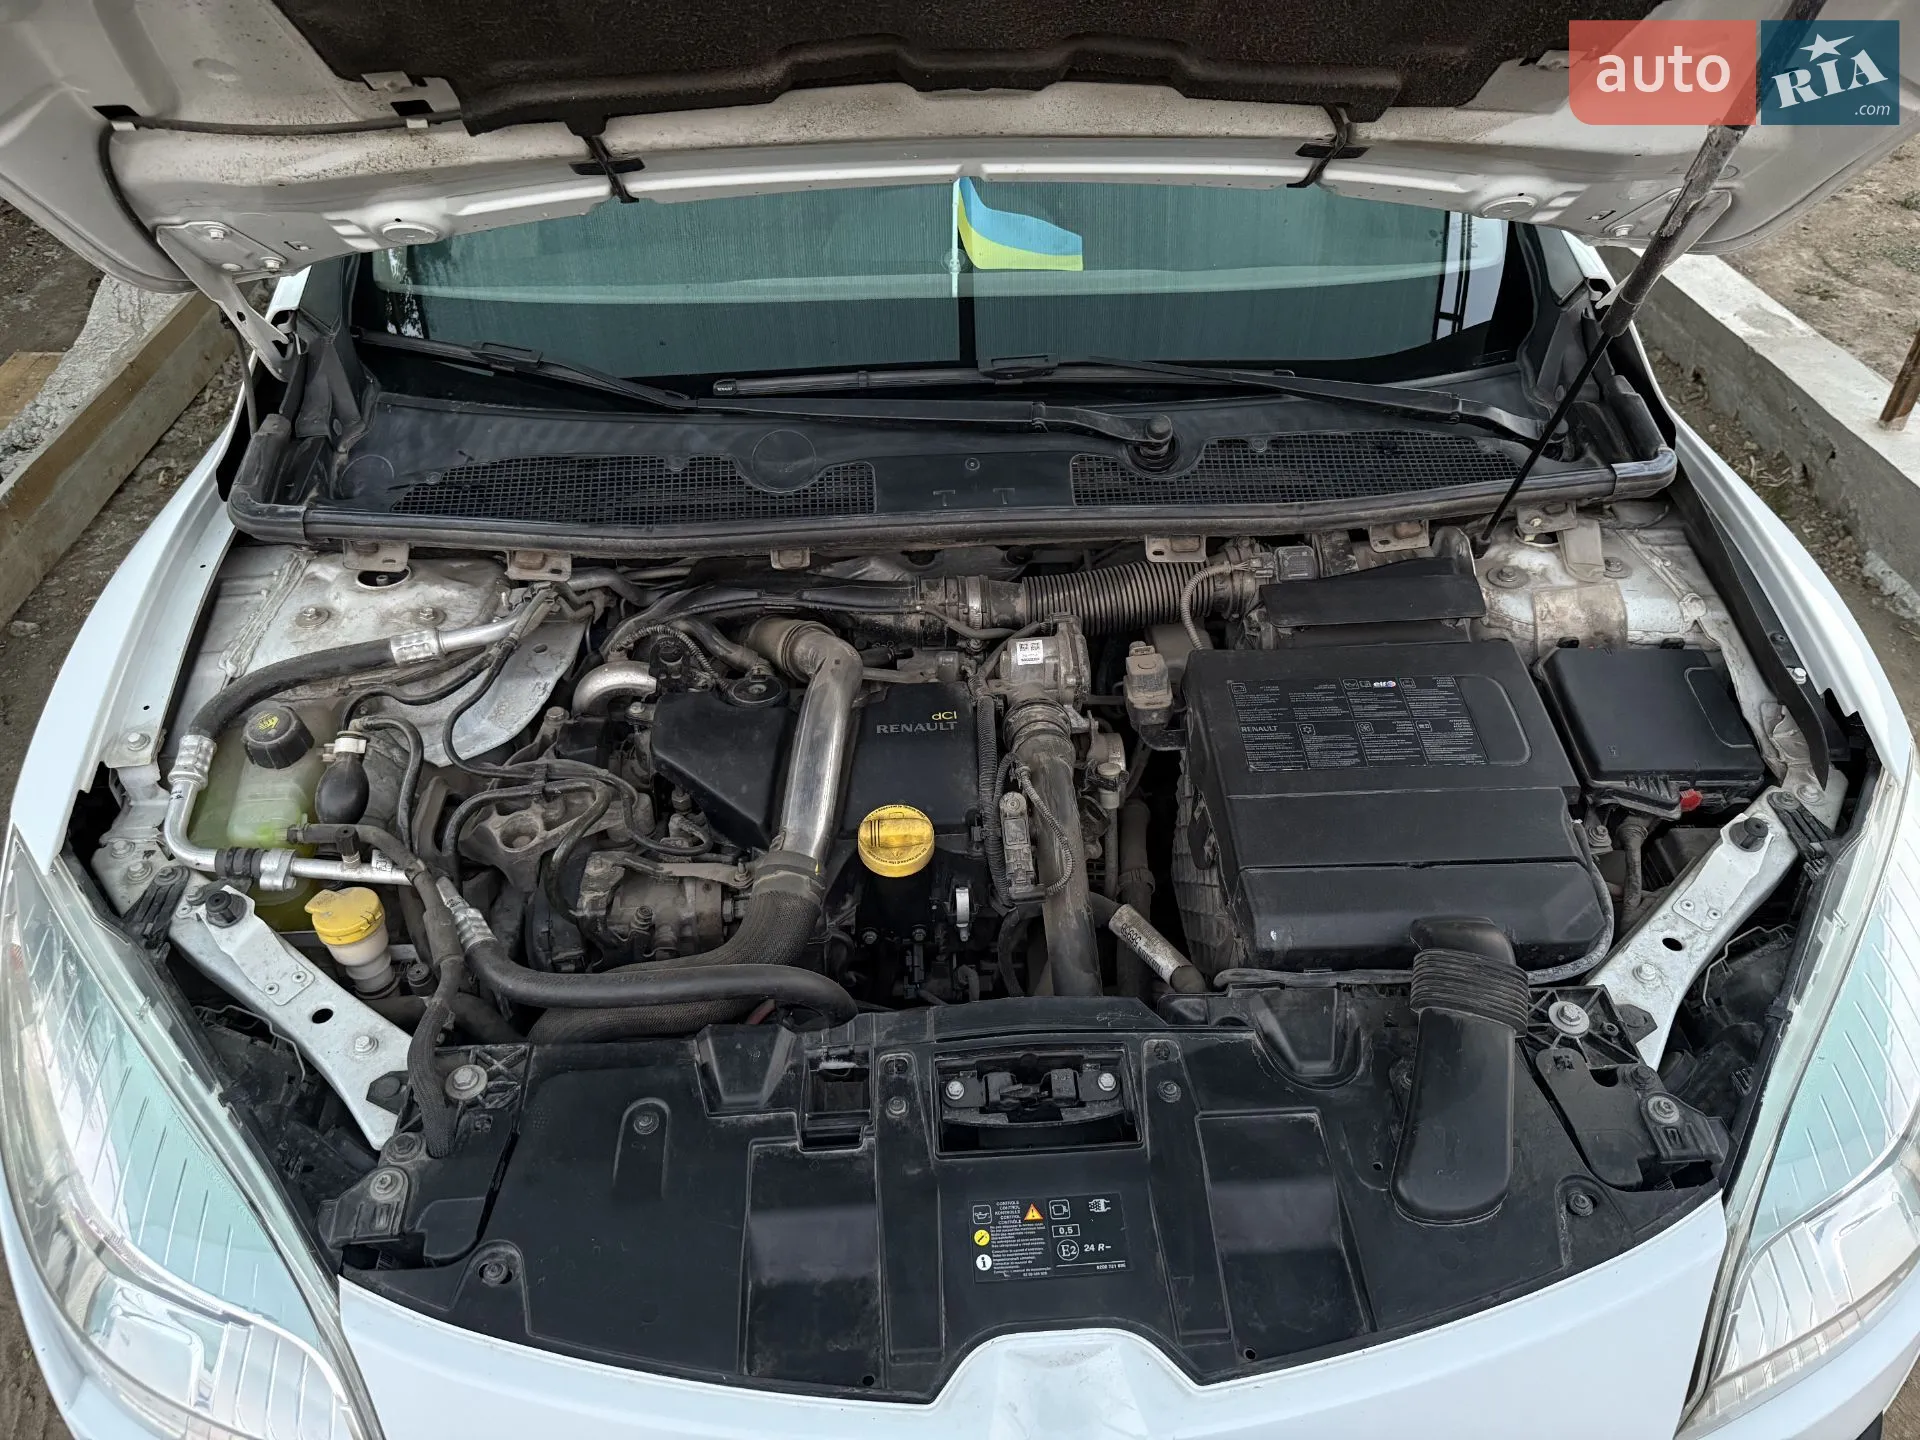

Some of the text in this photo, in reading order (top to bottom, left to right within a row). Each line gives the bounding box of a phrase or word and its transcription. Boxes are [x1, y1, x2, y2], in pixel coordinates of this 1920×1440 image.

[876, 721, 958, 734] RENAULT
[1240, 725, 1279, 733] RENAULT
[1059, 1227, 1074, 1235] 0,5
[1060, 1244, 1078, 1257] E2
[1083, 1244, 1095, 1252] 24
